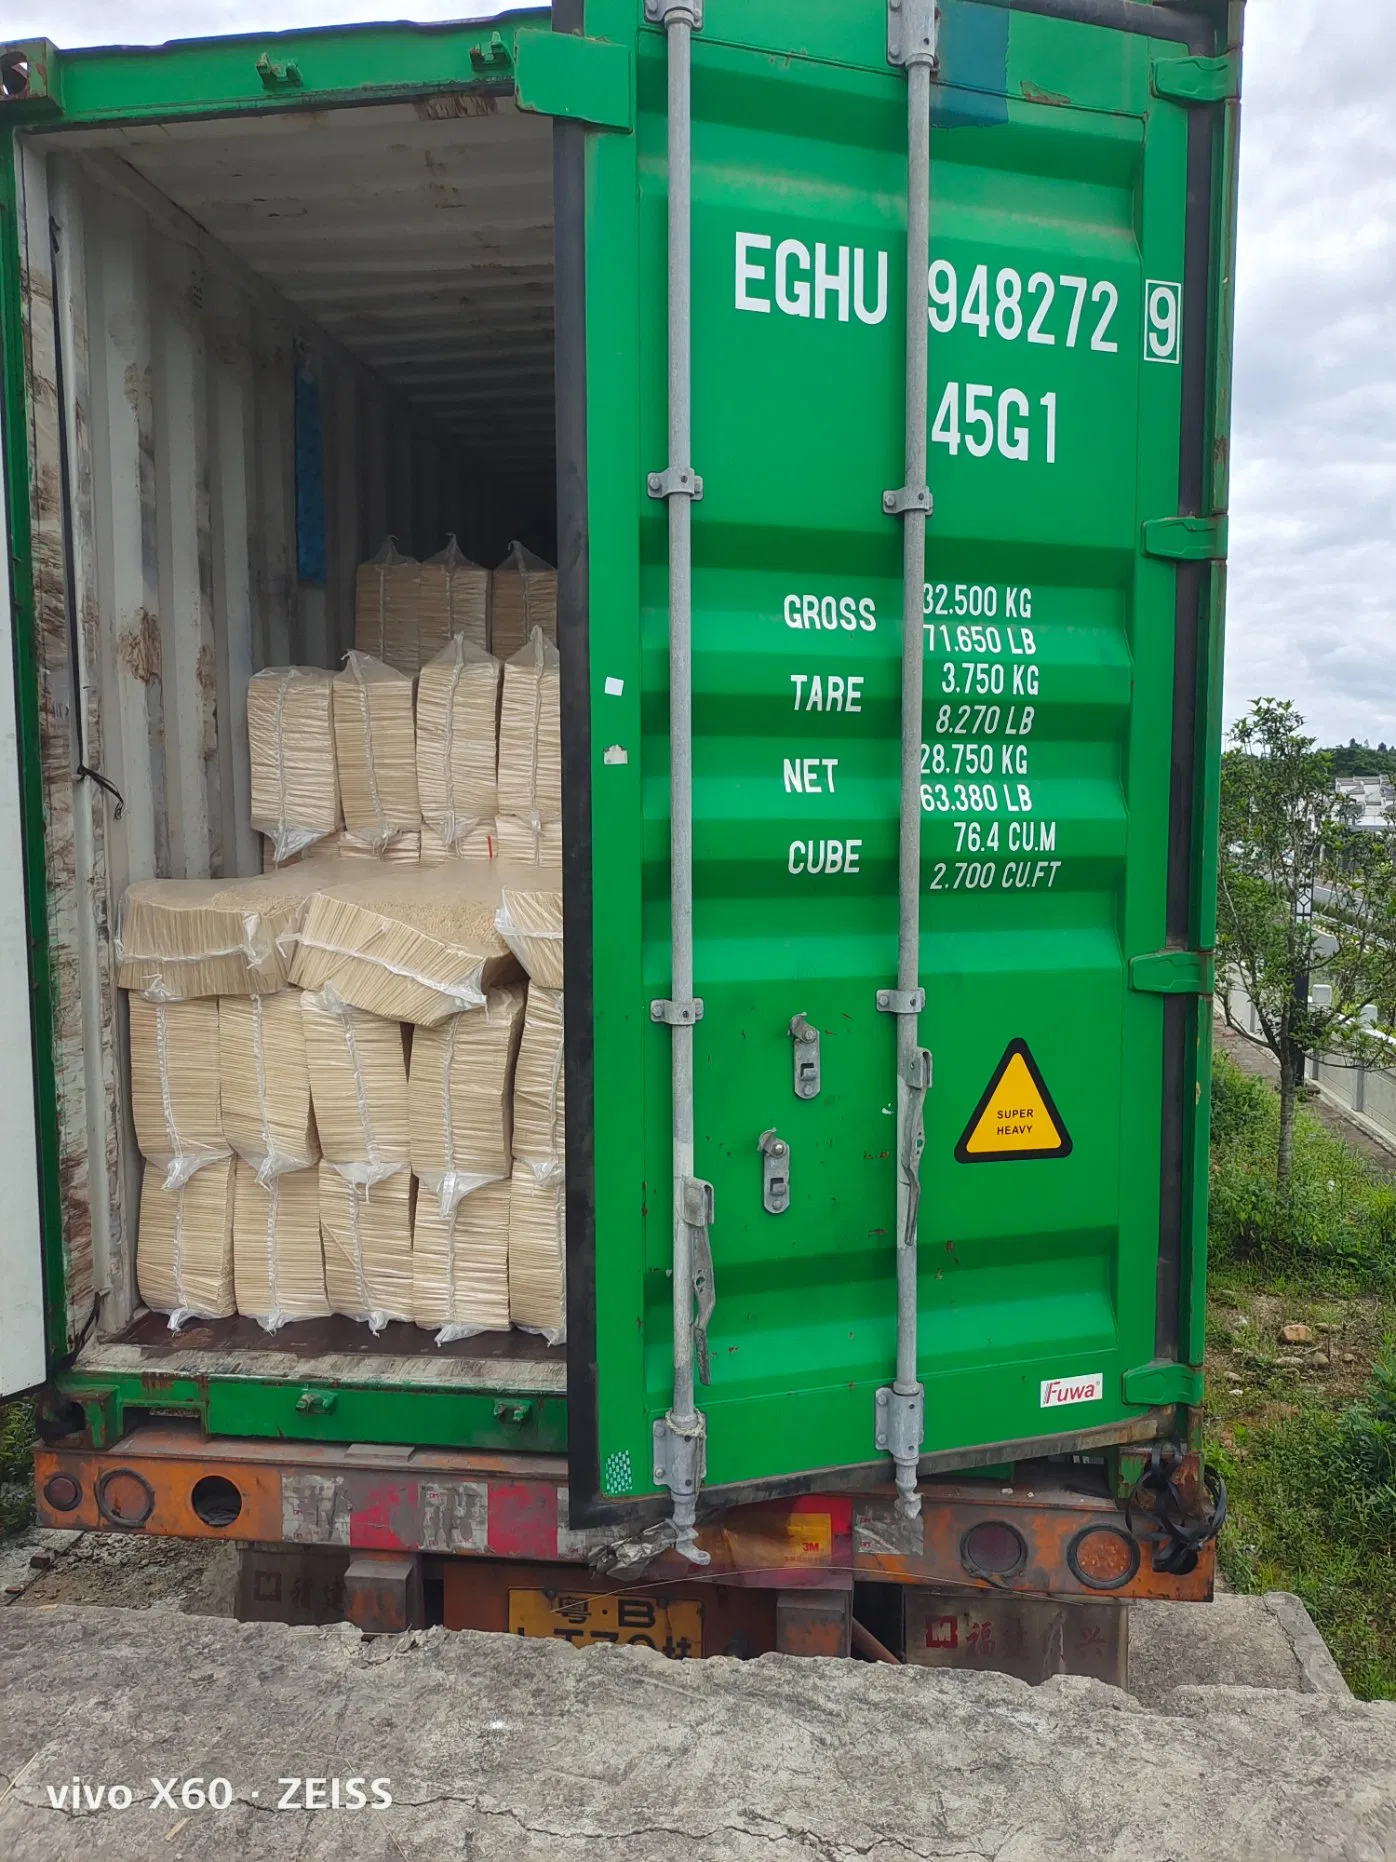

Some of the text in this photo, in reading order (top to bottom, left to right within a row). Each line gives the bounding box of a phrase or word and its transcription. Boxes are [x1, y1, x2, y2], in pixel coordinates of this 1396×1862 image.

[735, 231, 1178, 357] EGHU 948272 9
[931, 381, 1056, 463] 45G1
[783, 594, 877, 631] GROSS
[1005, 587, 1032, 618] KG
[1006, 627, 1037, 655] LB
[790, 674, 864, 712] TARE
[1012, 664, 1039, 696] KG
[1005, 705, 1035, 735] LB
[783, 758, 839, 793] NET
[1001, 744, 1028, 775] KG
[1003, 784, 1033, 812] LB
[788, 821, 1056, 874] CUBE 76.4 CU.M
[1001, 861, 1062, 888] CU.FT
[997, 1108, 1034, 1120] SUPER
[996, 1125, 1033, 1136] HEAVY
[1043, 1380, 1096, 1405] Fuwa
[802, 1542, 820, 1553] 3M
